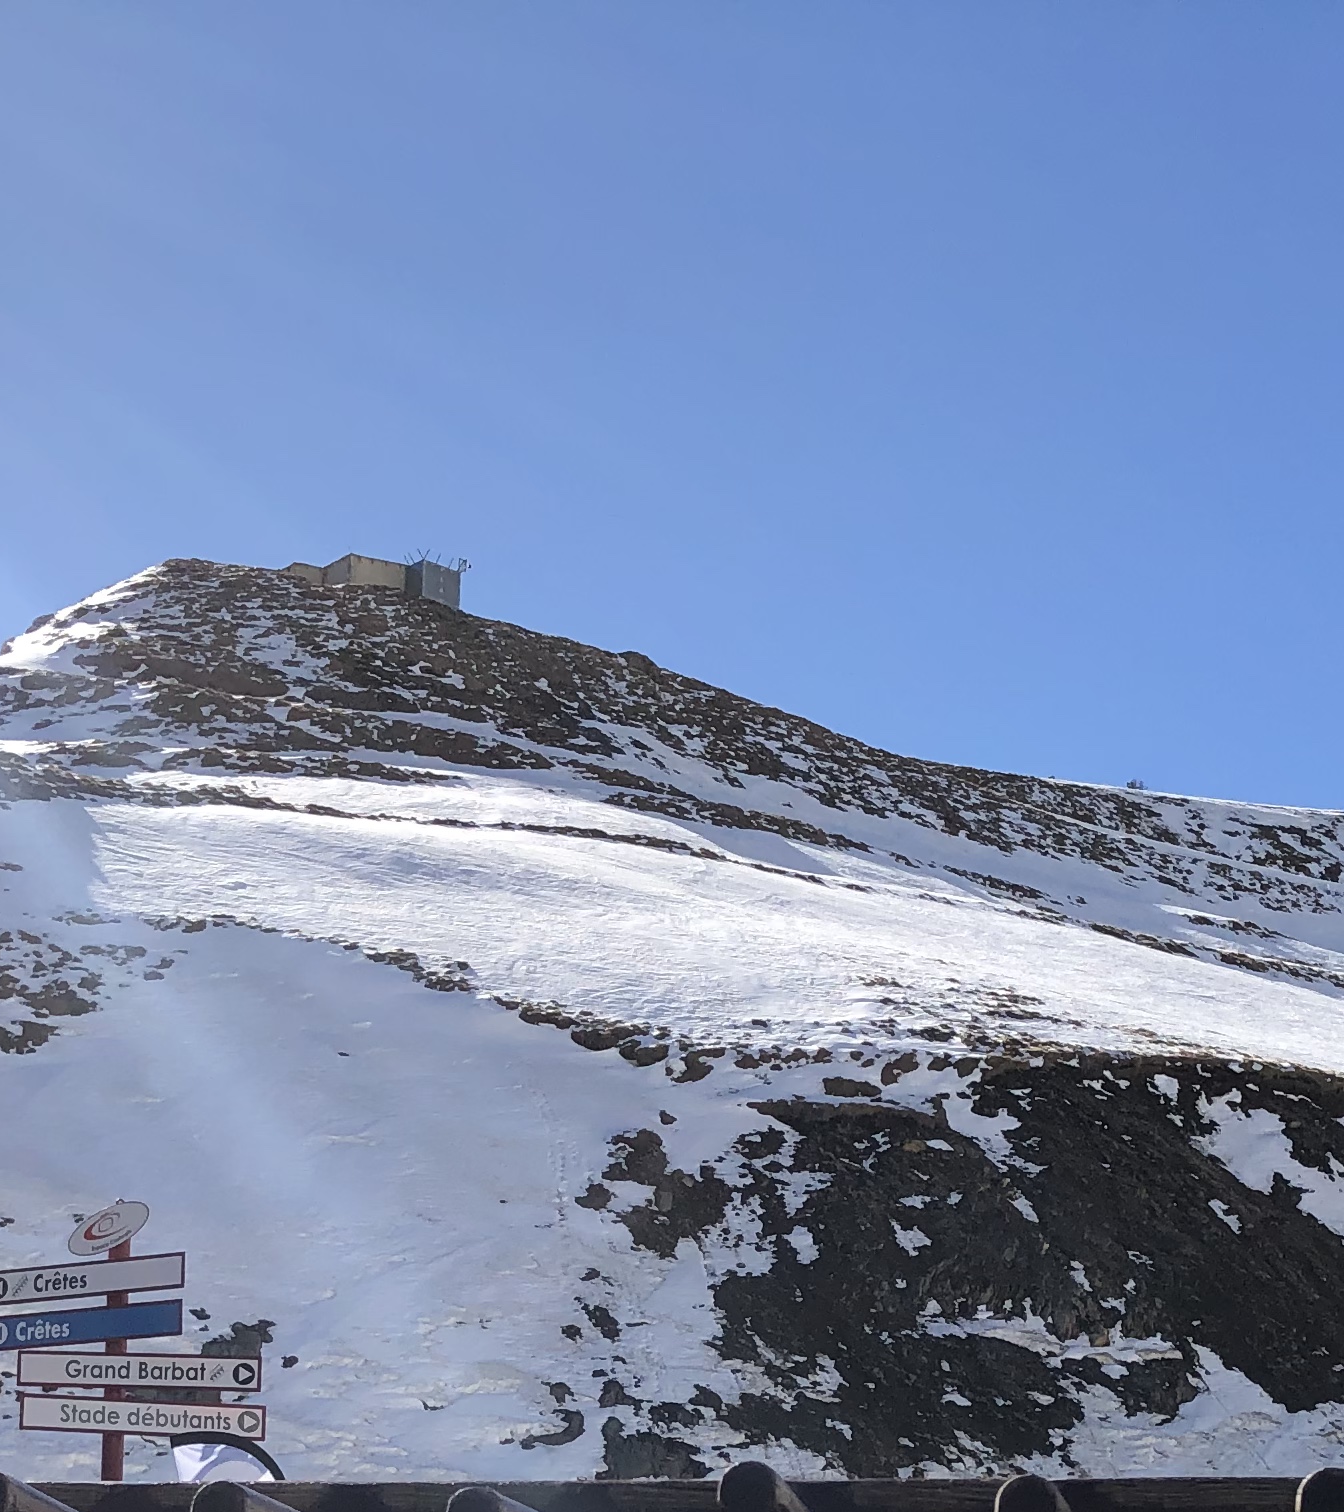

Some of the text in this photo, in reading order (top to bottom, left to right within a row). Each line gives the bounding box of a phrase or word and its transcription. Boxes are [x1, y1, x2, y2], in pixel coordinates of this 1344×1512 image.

[33, 1271, 88, 1293] Crêtes
[15, 1320, 70, 1342] Crêtes
[65, 1360, 206, 1382] Grand Barbat
[60, 1404, 231, 1431] Stade débutants
